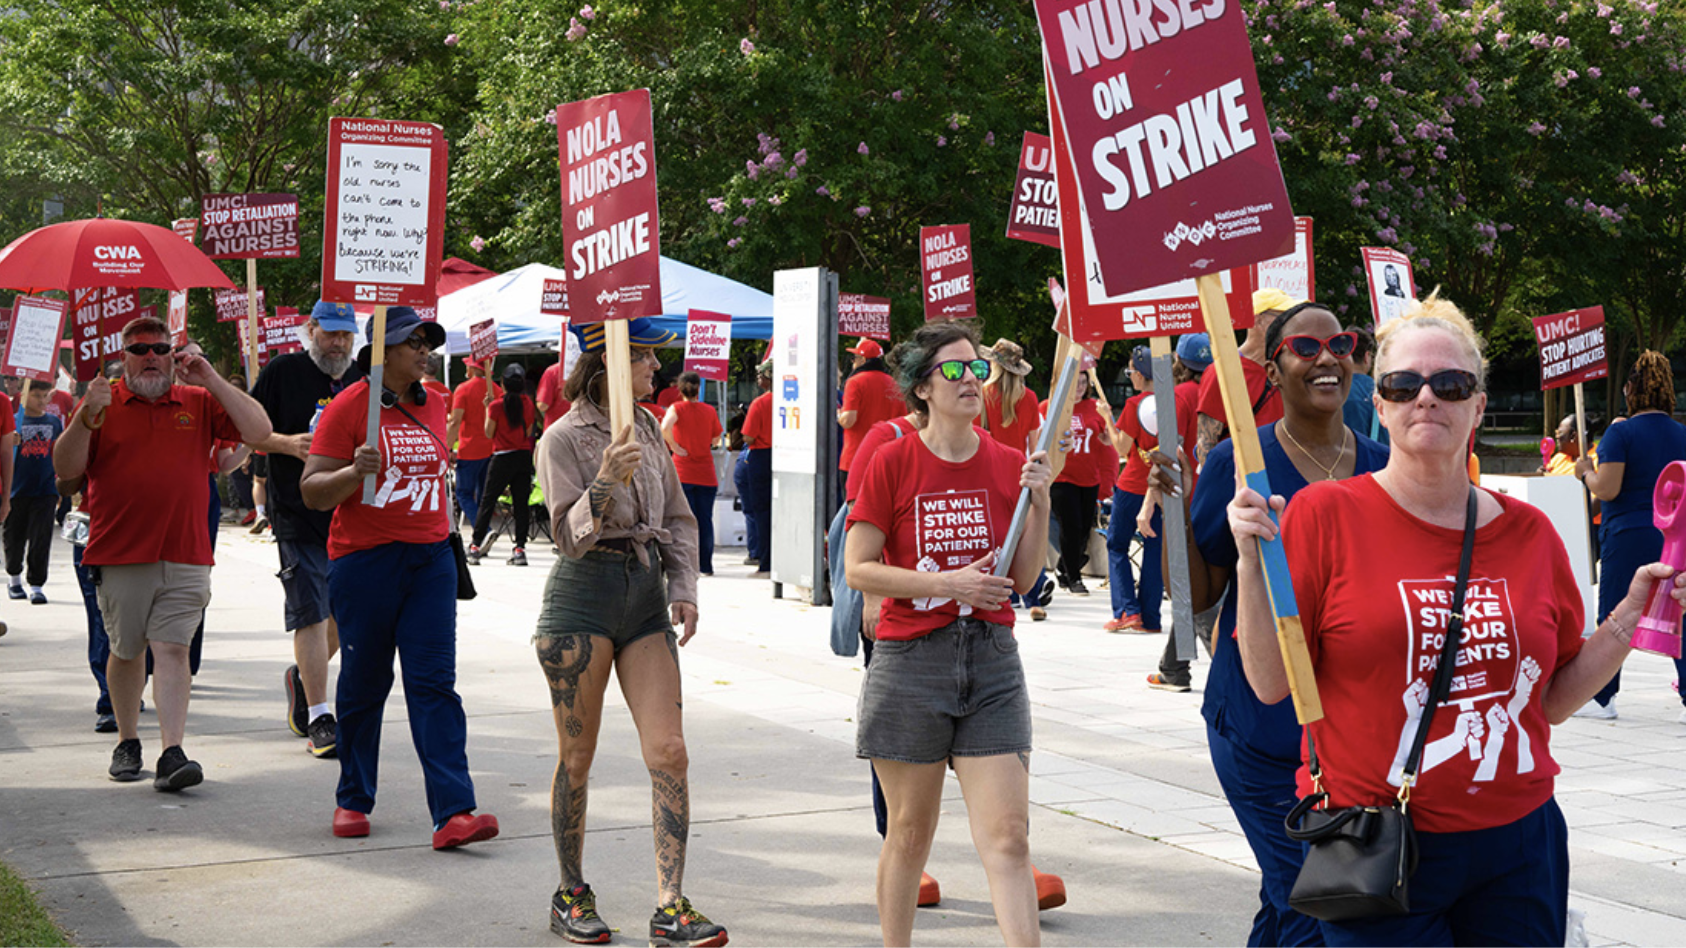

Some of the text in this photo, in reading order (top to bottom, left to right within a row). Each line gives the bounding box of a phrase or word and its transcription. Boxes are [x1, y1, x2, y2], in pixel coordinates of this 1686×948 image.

[1093, 72, 1133, 120] ON
[341, 121, 433, 136] National Nurses
[341, 132, 432, 144] Organizing Committee
[567, 109, 622, 165] NOLA
[1092, 78, 1257, 211] STRIKE
[346, 156, 362, 168] I'm
[403, 162, 421, 172] the
[568, 141, 648, 206] NURSES
[343, 177, 401, 188] old nurses
[1019, 177, 1057, 205] STO
[204, 194, 247, 211] UMC!
[343, 194, 371, 203] can't
[410, 198, 421, 208] to
[204, 202, 296, 225] STOP RETALIATION
[577, 205, 594, 231] ON
[1015, 205, 1060, 228] PATIE
[1214, 202, 1273, 221] National Nurses
[342, 212, 393, 227] the phone
[1217, 216, 1260, 231] Organizing
[205, 217, 296, 241] AGAINST
[343, 227, 367, 242] right
[1219, 225, 1262, 240] Committee
[215, 232, 297, 255] NURSES
[572, 211, 650, 280] STRIKE
[925, 231, 956, 253] NOLA
[94, 245, 142, 259] CWA
[390, 249, 419, 260] we're
[926, 245, 969, 271] NURSES
[355, 259, 413, 276] STRIKING!
[931, 270, 942, 282] ON
[75, 286, 118, 305] NOA
[928, 274, 971, 303] STRIKE
[839, 294, 864, 304] UMC!
[1159, 301, 1199, 312] National
[266, 317, 295, 329] UMC!
[839, 313, 888, 324] AGAINST
[1160, 312, 1192, 321] Nurses
[83, 324, 97, 338] ON
[690, 324, 717, 334] Don't
[844, 322, 889, 333] NURSES
[1160, 320, 1192, 331] United
[1536, 314, 1580, 343] UMC!
[689, 334, 727, 346] Sideline
[1542, 326, 1604, 365] STOP HURTING
[688, 346, 721, 356] Nurses
[1543, 358, 1571, 380] PATIENT
[1572, 345, 1606, 371] ADVOCATES
[391, 437, 432, 445] STRIKE
[415, 445, 436, 453] OUR
[393, 454, 438, 463] PATIENTS
[922, 497, 983, 512] WE WILL
[924, 511, 986, 527] STRIKE
[924, 526, 988, 540] FOR OUR
[925, 538, 990, 553] PATIENTS
[1412, 585, 1499, 604] WE ILL
[1420, 601, 1503, 628] STKE
[1421, 633, 1446, 650] FO
[1418, 642, 1511, 672] PAENTS
